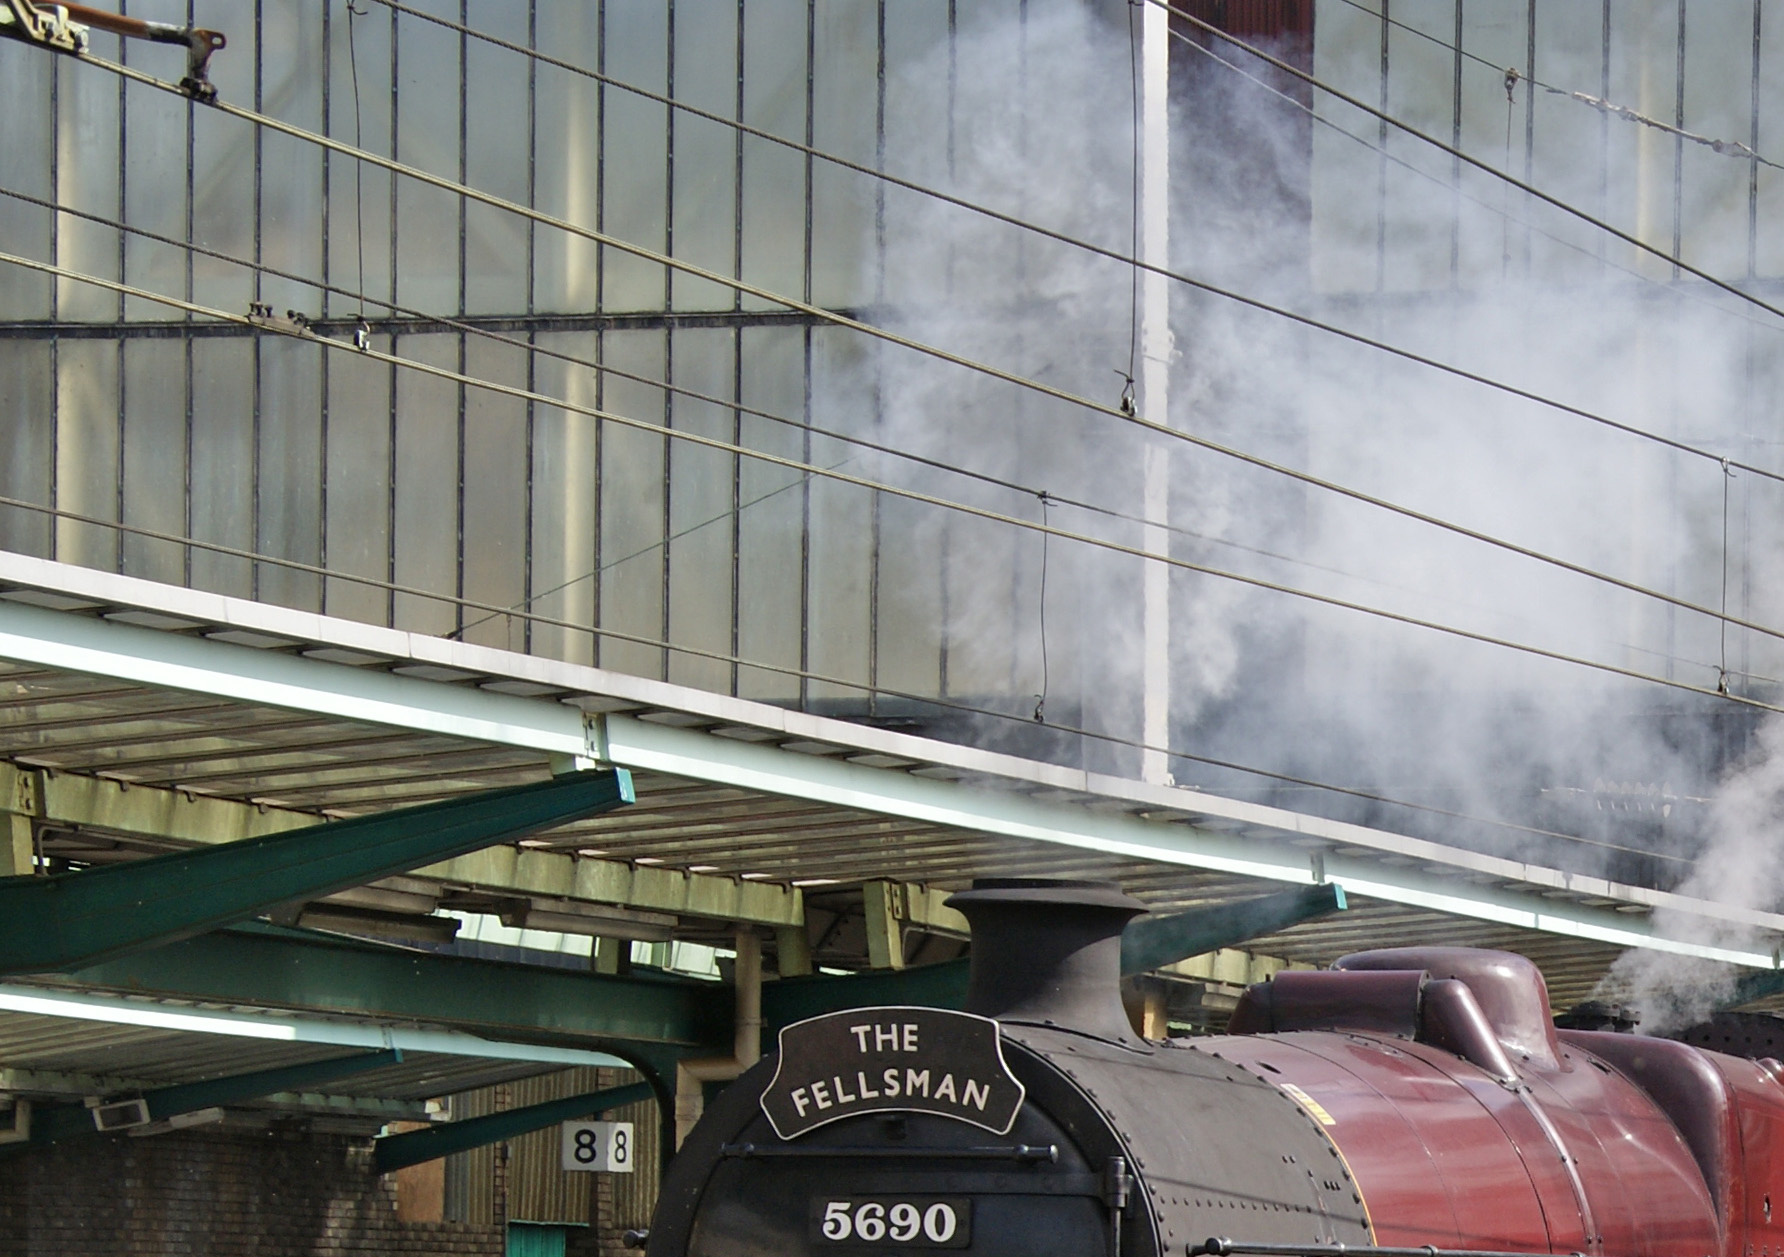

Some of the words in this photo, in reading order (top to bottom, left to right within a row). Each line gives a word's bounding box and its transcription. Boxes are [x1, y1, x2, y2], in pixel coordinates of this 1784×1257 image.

[850, 1023, 919, 1053] THE
[790, 1068, 990, 1118] FELLSMAN
[574, 1129, 596, 1164] 8
[615, 1130, 626, 1164] 8
[822, 1202, 956, 1243] 5690
